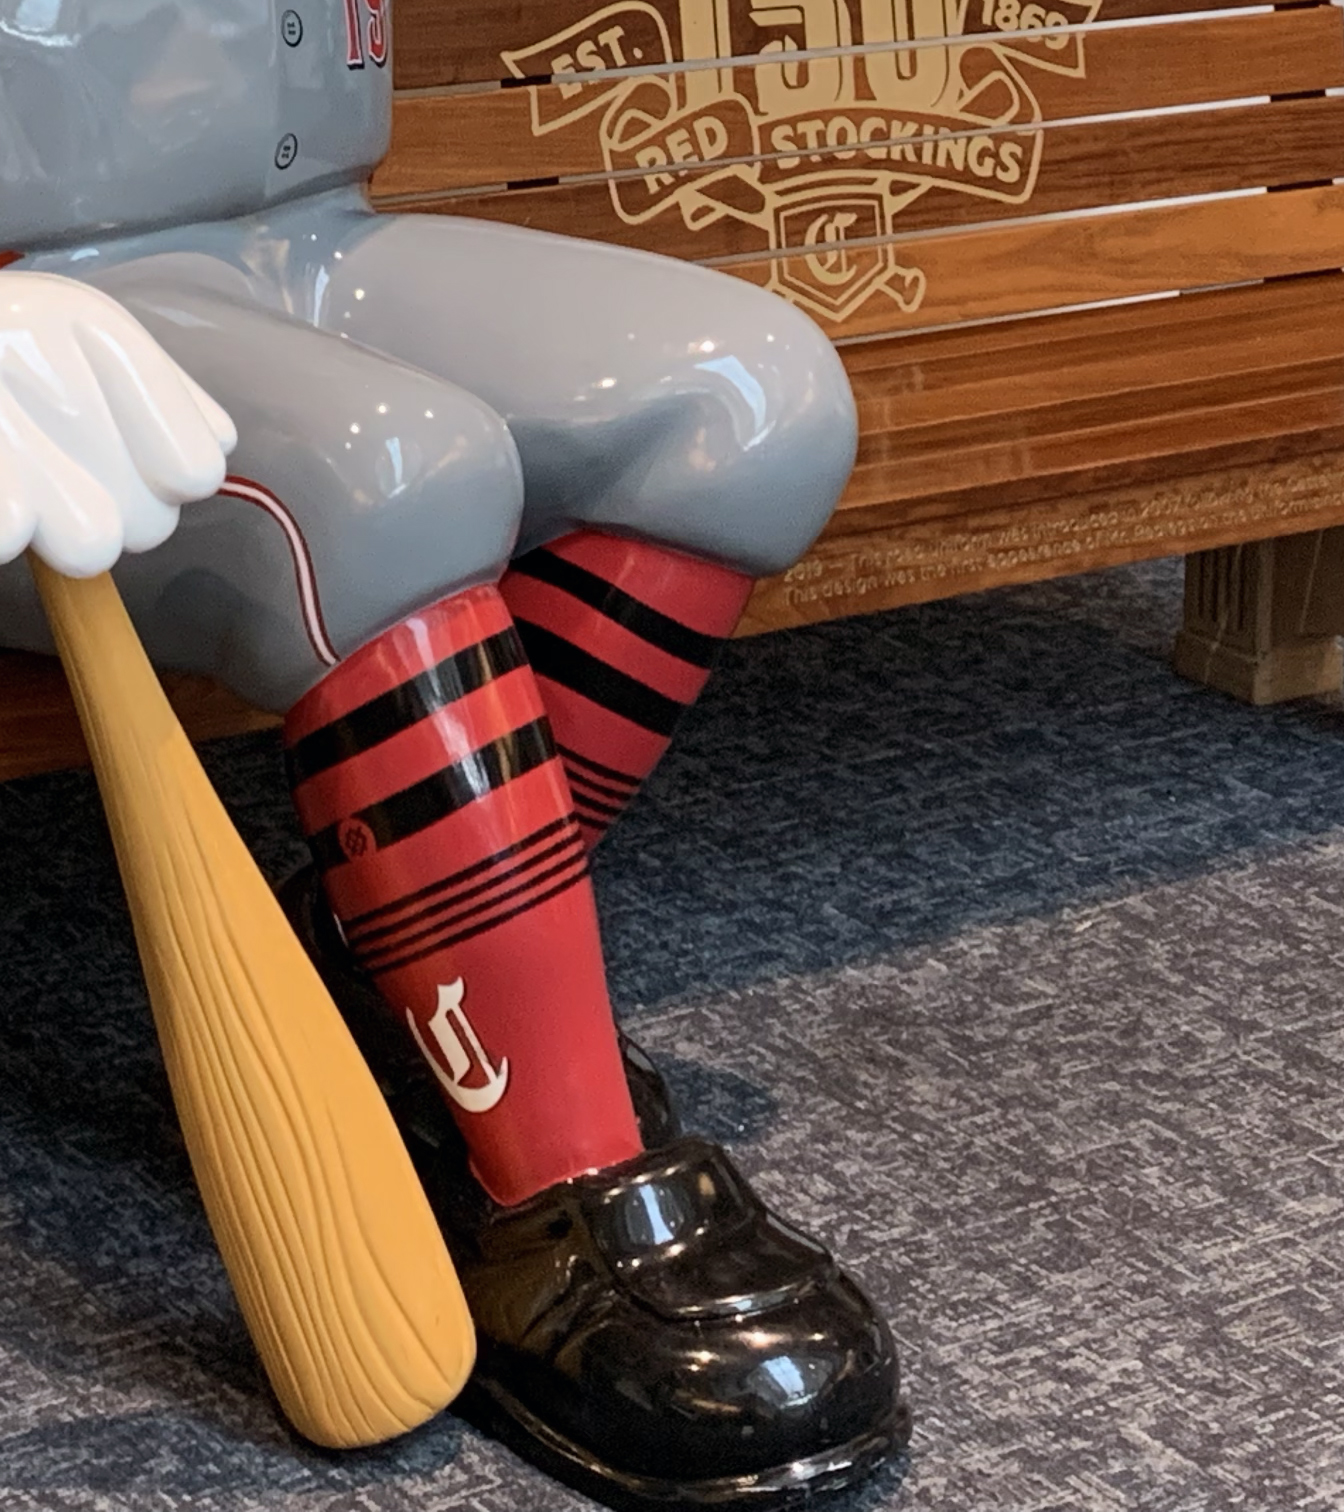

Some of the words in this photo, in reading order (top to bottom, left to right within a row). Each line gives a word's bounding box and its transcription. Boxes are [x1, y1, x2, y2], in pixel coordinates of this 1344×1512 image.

[551, 25, 644, 100] EST.
[634, 116, 728, 194] RED
[770, 115, 1023, 183] STOCKINGS
[822, 571, 878, 600] design
